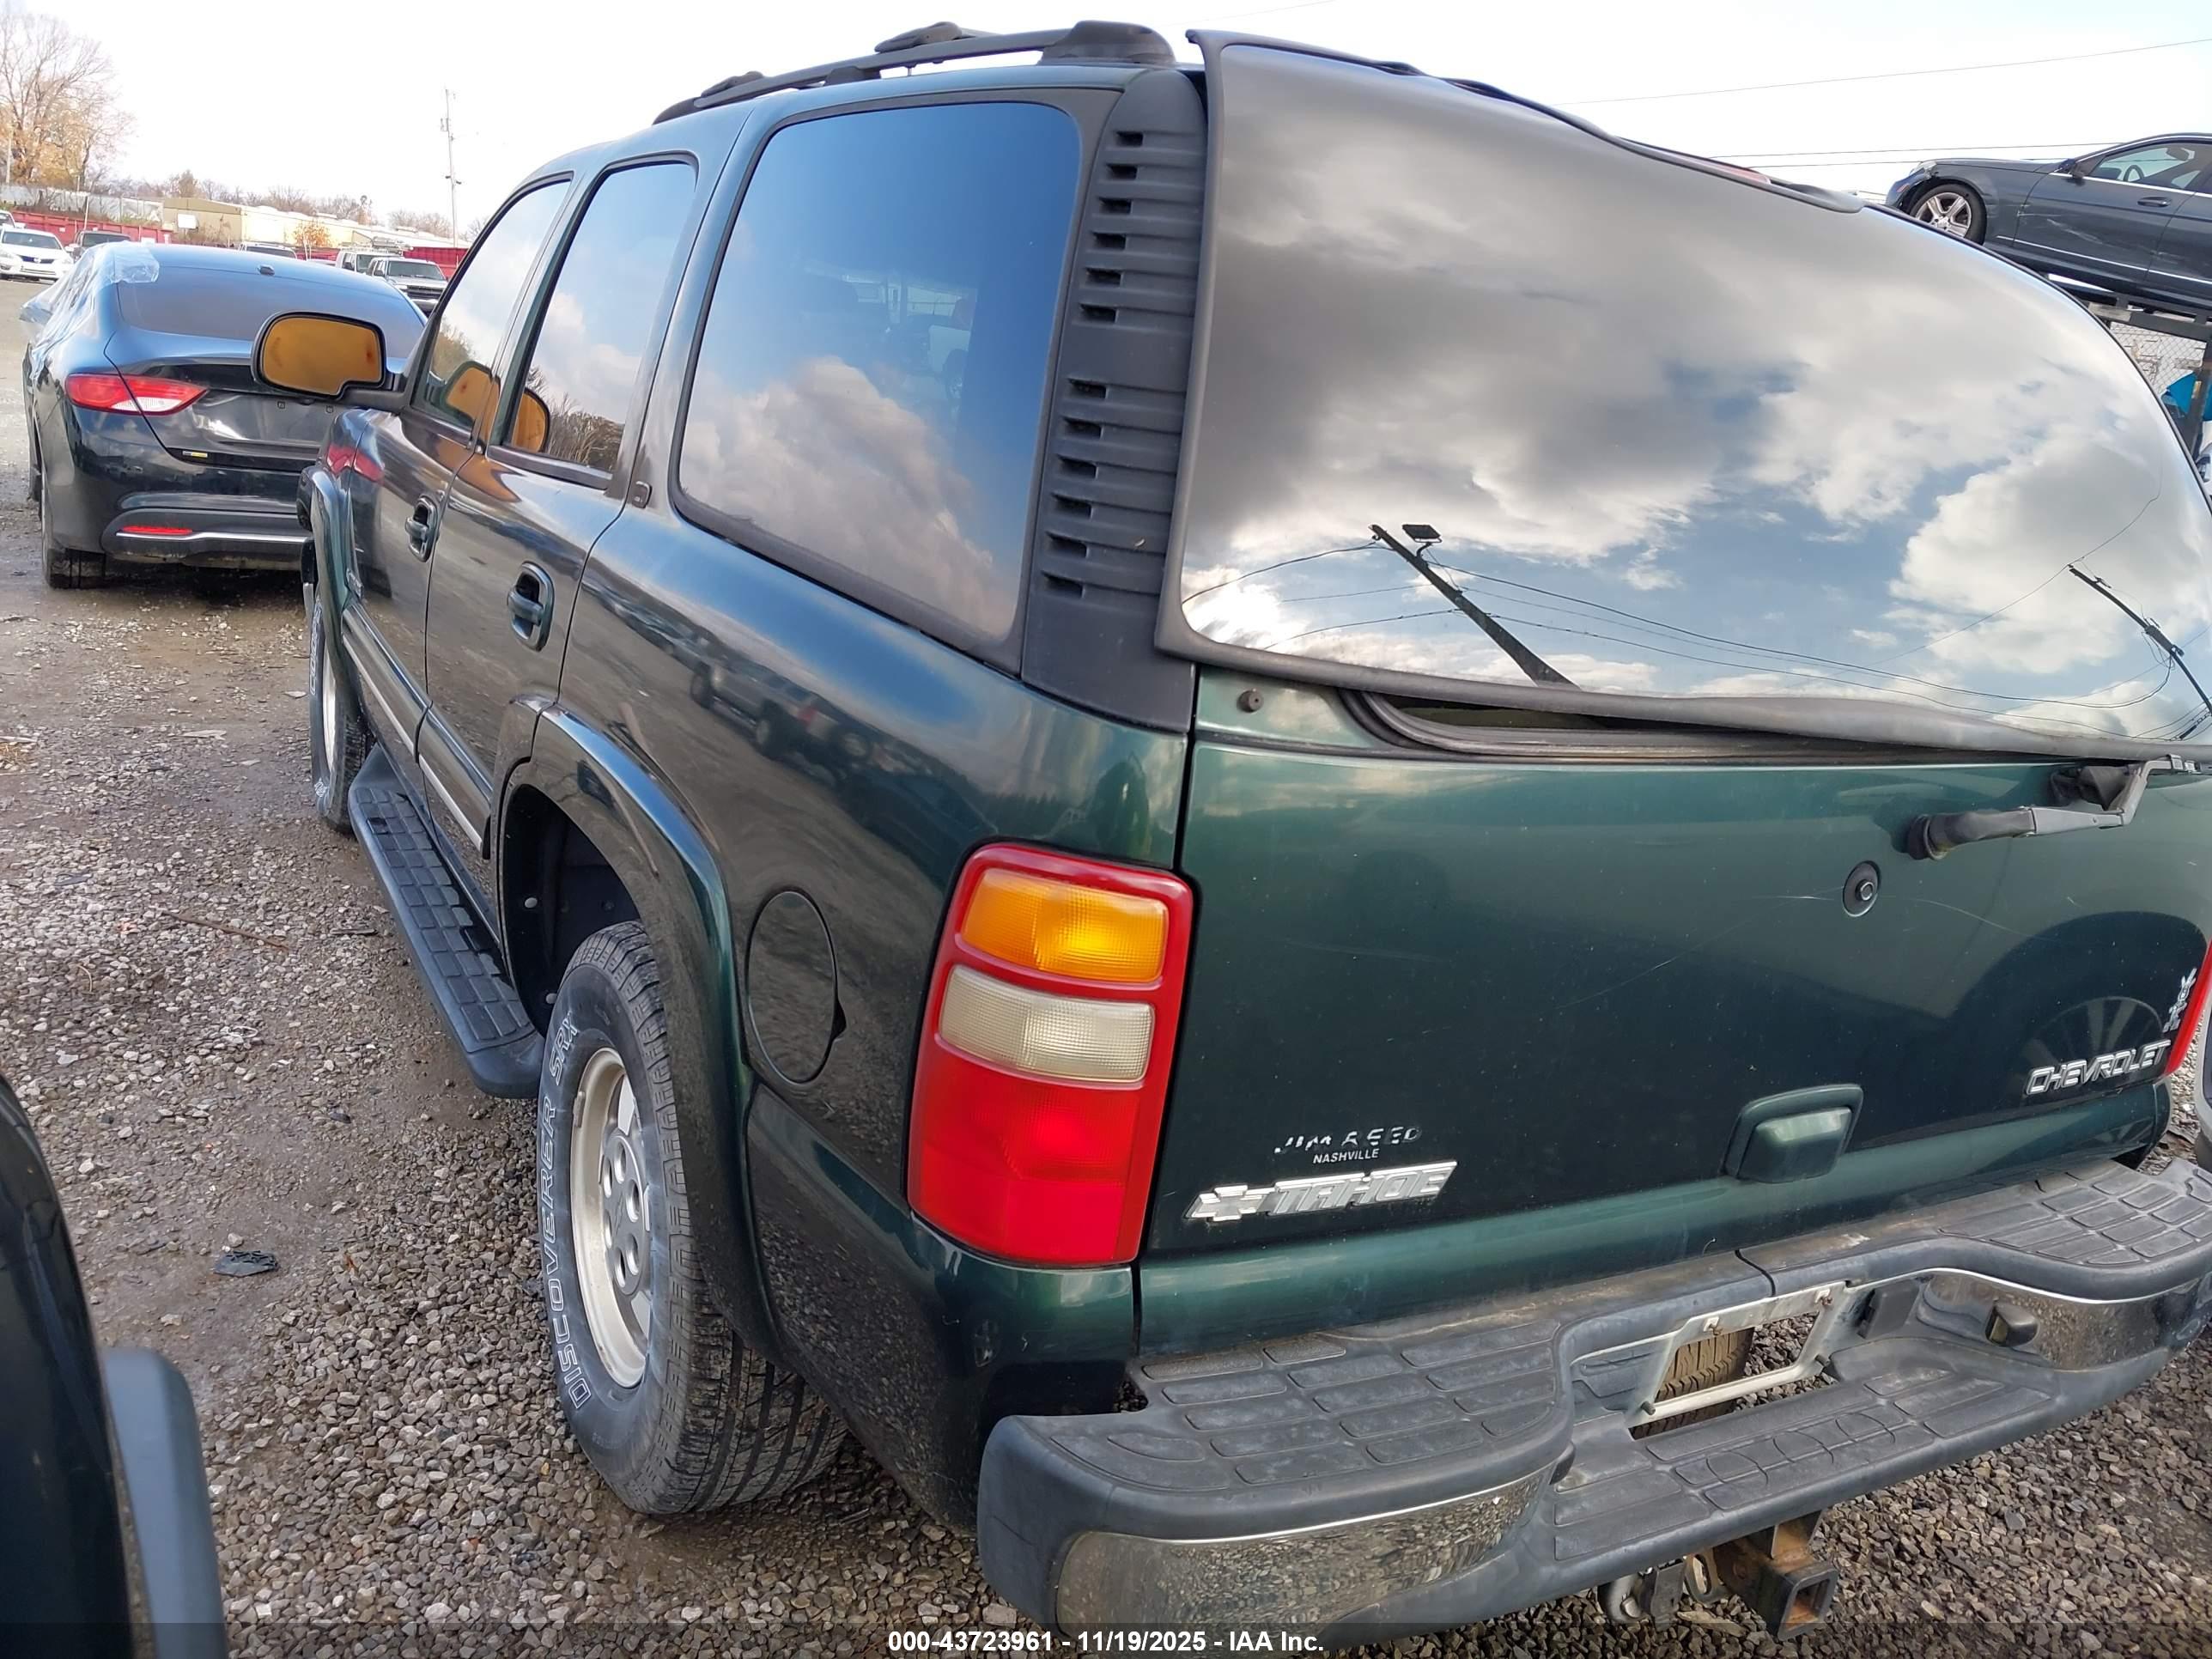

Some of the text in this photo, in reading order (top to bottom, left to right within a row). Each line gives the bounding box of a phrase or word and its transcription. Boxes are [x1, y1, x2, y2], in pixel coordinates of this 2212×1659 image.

[2027, 1039, 2172, 1095] CHEVROLET
[1312, 1148, 1380, 1164] NASHVILLE
[1267, 1161, 1457, 1216] TAHOE
[537, 1096, 592, 1408] DISCOVERER
